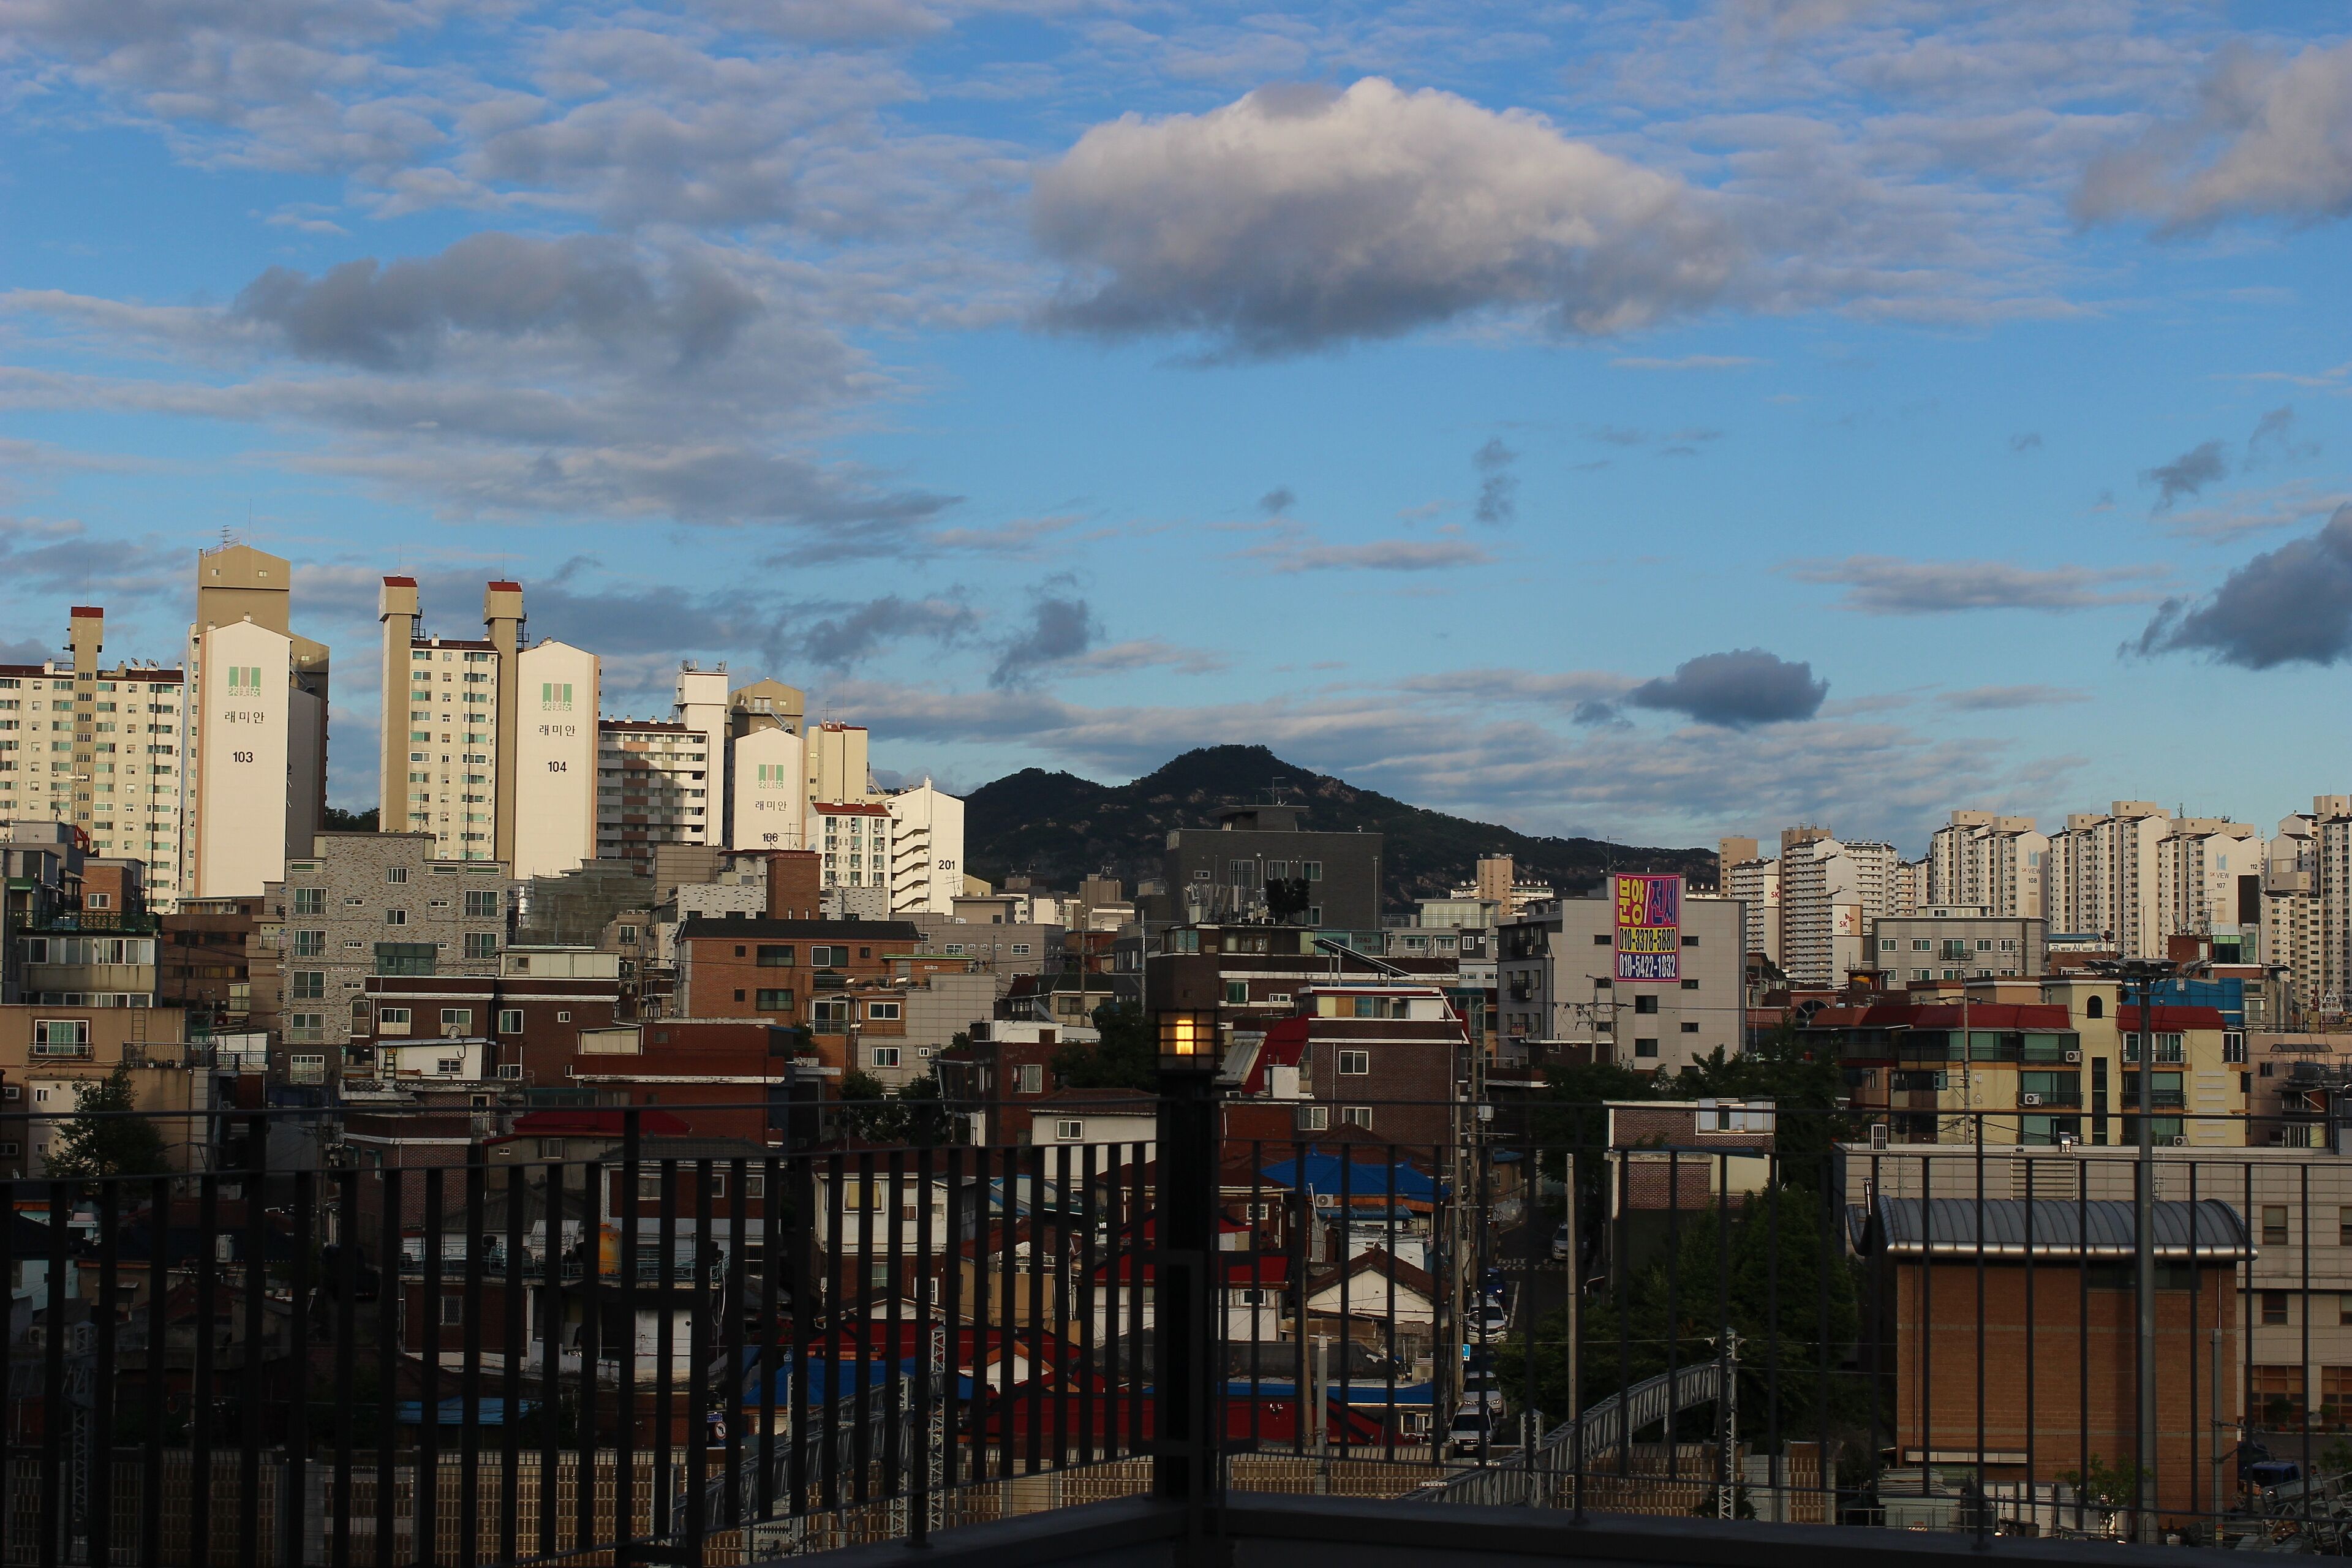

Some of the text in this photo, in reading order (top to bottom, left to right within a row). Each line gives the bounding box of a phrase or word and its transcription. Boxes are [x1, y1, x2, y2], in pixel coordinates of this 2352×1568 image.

[225, 711, 265, 724] 래미안
[539, 725, 576, 737] 래미안
[233, 751, 254, 763] 103
[548, 761, 567, 773] 104
[755, 801, 787, 811] 래미안
[762, 833, 778, 842] 106
[938, 860, 956, 870] 201
[1619, 878, 1676, 924] 분양/전세
[1619, 954, 1675, 978] 010-5422-1832
